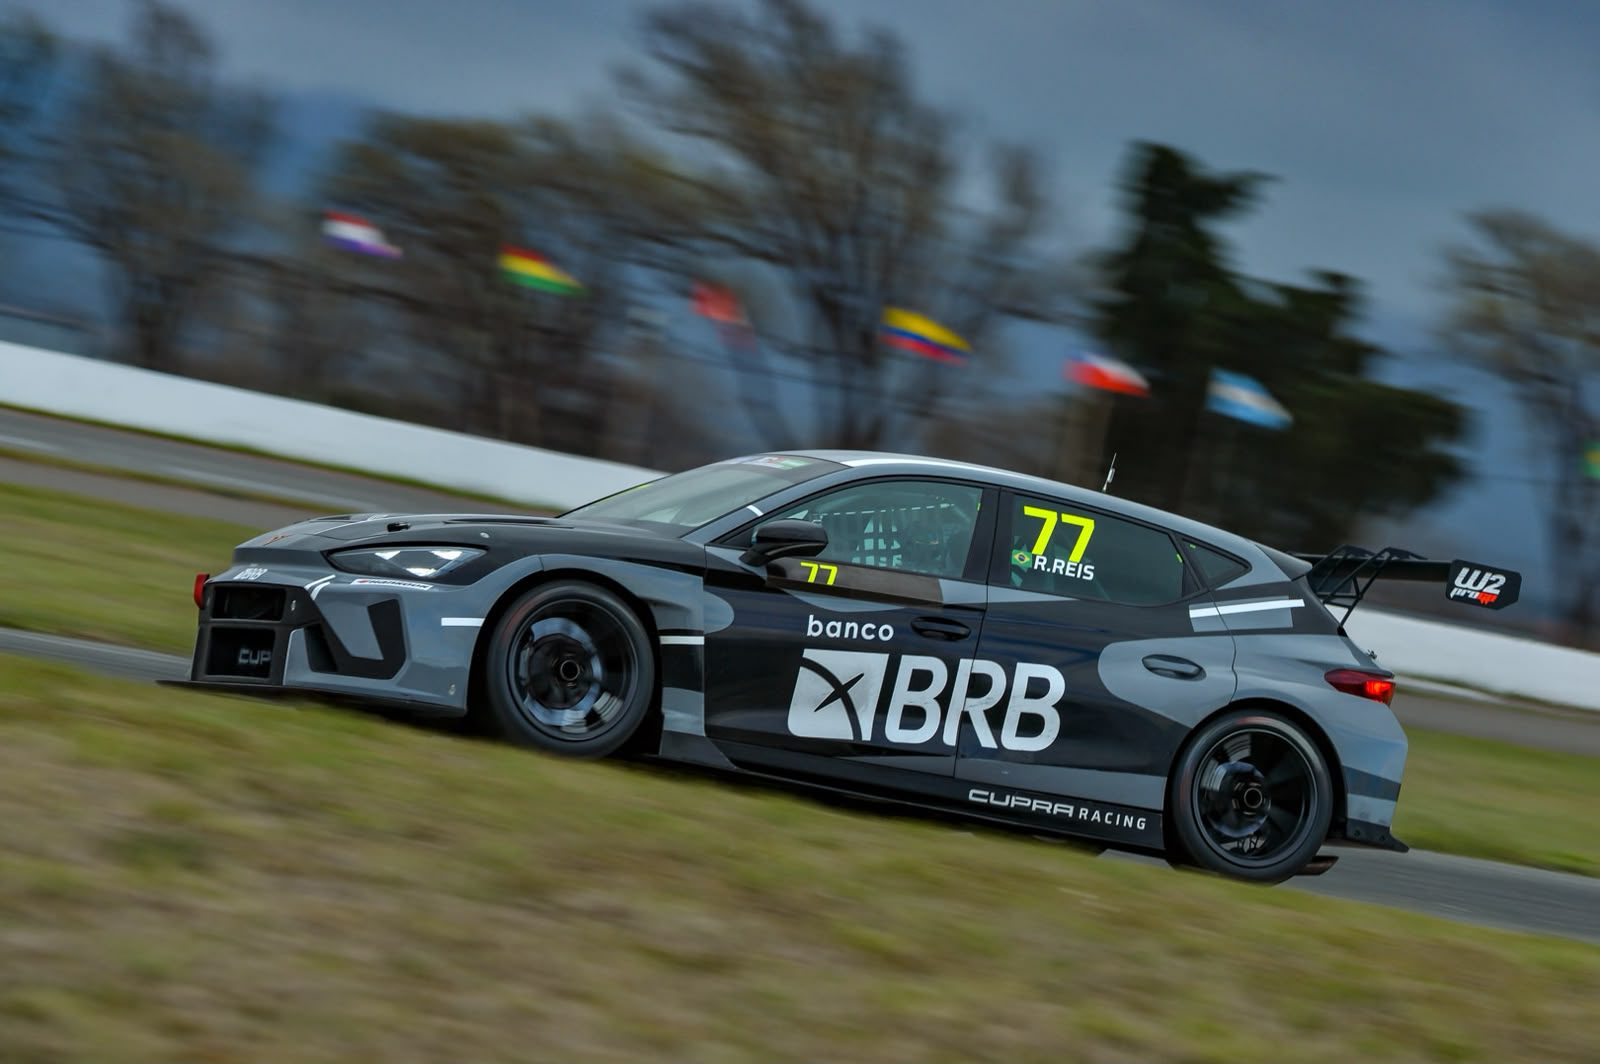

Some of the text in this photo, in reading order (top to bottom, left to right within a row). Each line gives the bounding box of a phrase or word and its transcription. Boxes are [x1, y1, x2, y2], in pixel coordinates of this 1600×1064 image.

[1023, 505, 1095, 563] 77
[800, 562, 838, 586] 77
[1033, 555, 1095, 580] R.REIS
[1454, 567, 1506, 595] W2
[806, 614, 894, 641] banco
[885, 654, 1066, 752] BRB
[968, 788, 1147, 831] CUPRA RACING
